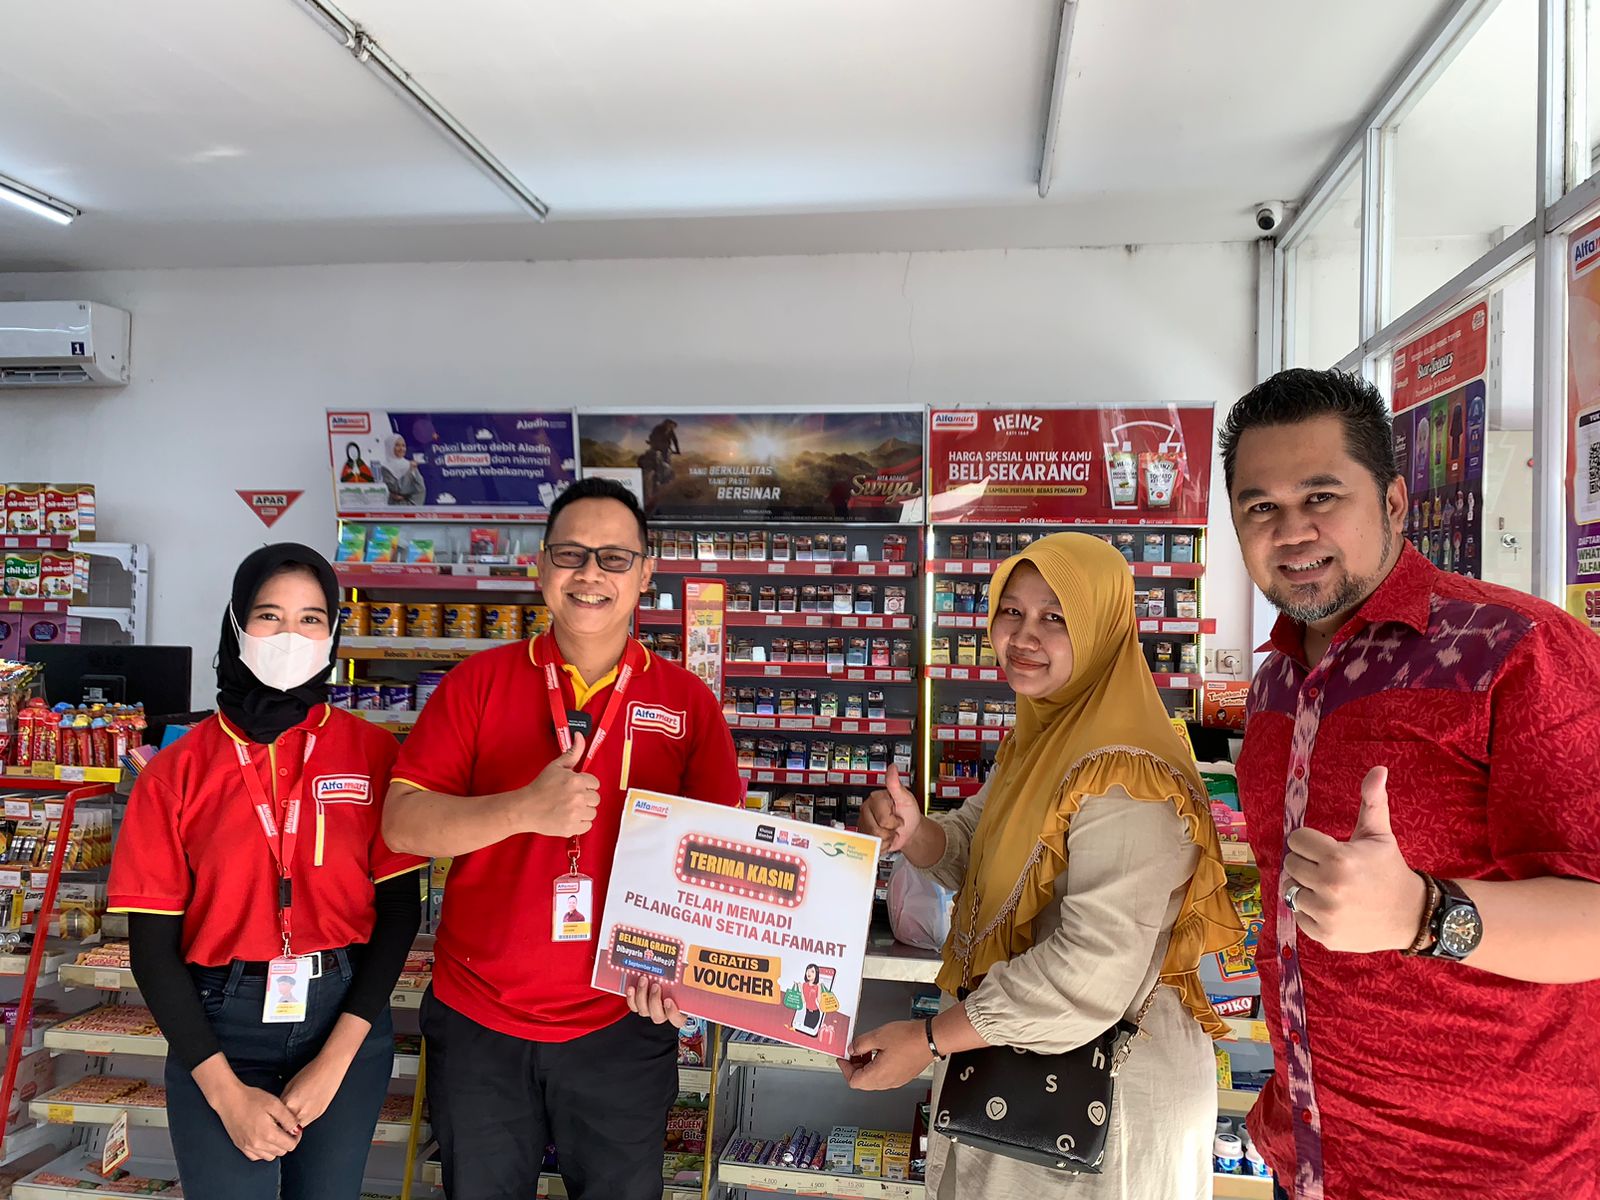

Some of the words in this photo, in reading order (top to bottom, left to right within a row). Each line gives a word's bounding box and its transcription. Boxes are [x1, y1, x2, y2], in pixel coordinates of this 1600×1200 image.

[74, 344, 82, 354] 1
[516, 418, 549, 430] Aladin
[935, 414, 975, 422] Alfamart
[992, 414, 1043, 432] HEINZ
[432, 443, 460, 454] Pakai
[461, 443, 488, 452] kartu
[489, 442, 516, 452] debit
[518, 443, 551, 453] Aladin
[434, 456, 444, 466] di
[446, 454, 490, 464] Alfamart
[492, 455, 512, 464] dan
[512, 455, 551, 466] nikmati
[948, 451, 983, 462] HARGA
[985, 451, 1022, 462] SPESIAL
[1025, 451, 1059, 462] UNTUK
[1062, 451, 1092, 462] KAMU
[442, 468, 478, 478] banyak
[480, 466, 544, 478] kebaikannya!
[709, 466, 774, 476] BERKUALITAS
[948, 463, 984, 480] BELI
[988, 463, 1090, 481] SEKARANG!
[728, 477, 750, 485] PASTI
[717, 486, 780, 500] BERSINAR
[850, 474, 922, 505] Surya
[256, 496, 284, 504] APAR
[635, 708, 678, 726] Alfamart
[321, 780, 368, 792] Alfamart
[635, 800, 670, 814] Alfamart
[690, 850, 745, 880] TERIMA
[748, 864, 796, 892] KASIH
[677, 890, 724, 914] TELAH
[726, 902, 792, 930] MENJADI
[625, 890, 713, 928] PELANGGAN
[716, 918, 759, 940] SETIA
[761, 929, 847, 958] ALFAMART
[619, 932, 649, 948] BELANJA
[649, 940, 677, 956] GRATIS
[708, 952, 760, 970] GRATIS
[693, 966, 774, 996] VOUCHER
[1046, 1074, 1058, 1092] S
[938, 1110, 950, 1128] G
[683, 1130, 705, 1140] Bites
[856, 1140, 881, 1148] Ricola
[1056, 1134, 1076, 1152] G
[884, 1148, 909, 1156] Ricola
